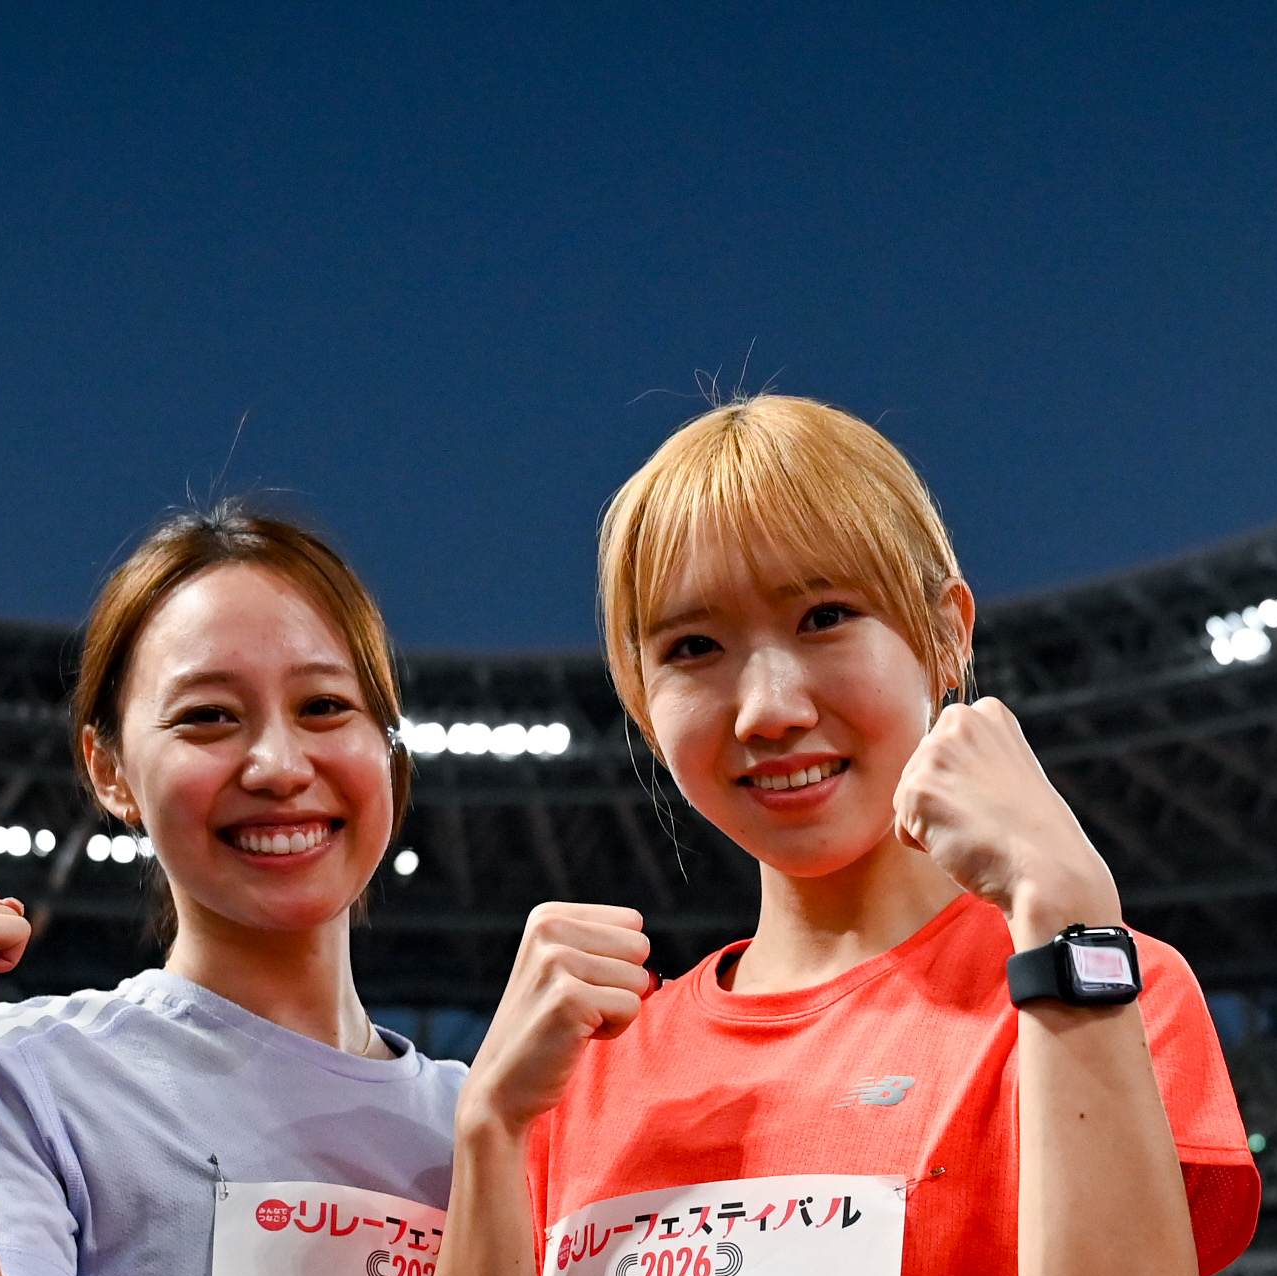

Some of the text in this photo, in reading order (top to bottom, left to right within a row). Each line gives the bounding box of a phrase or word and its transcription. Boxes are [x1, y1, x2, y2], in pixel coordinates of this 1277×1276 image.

[571, 1195, 862, 1263] リレーフェスティバル
